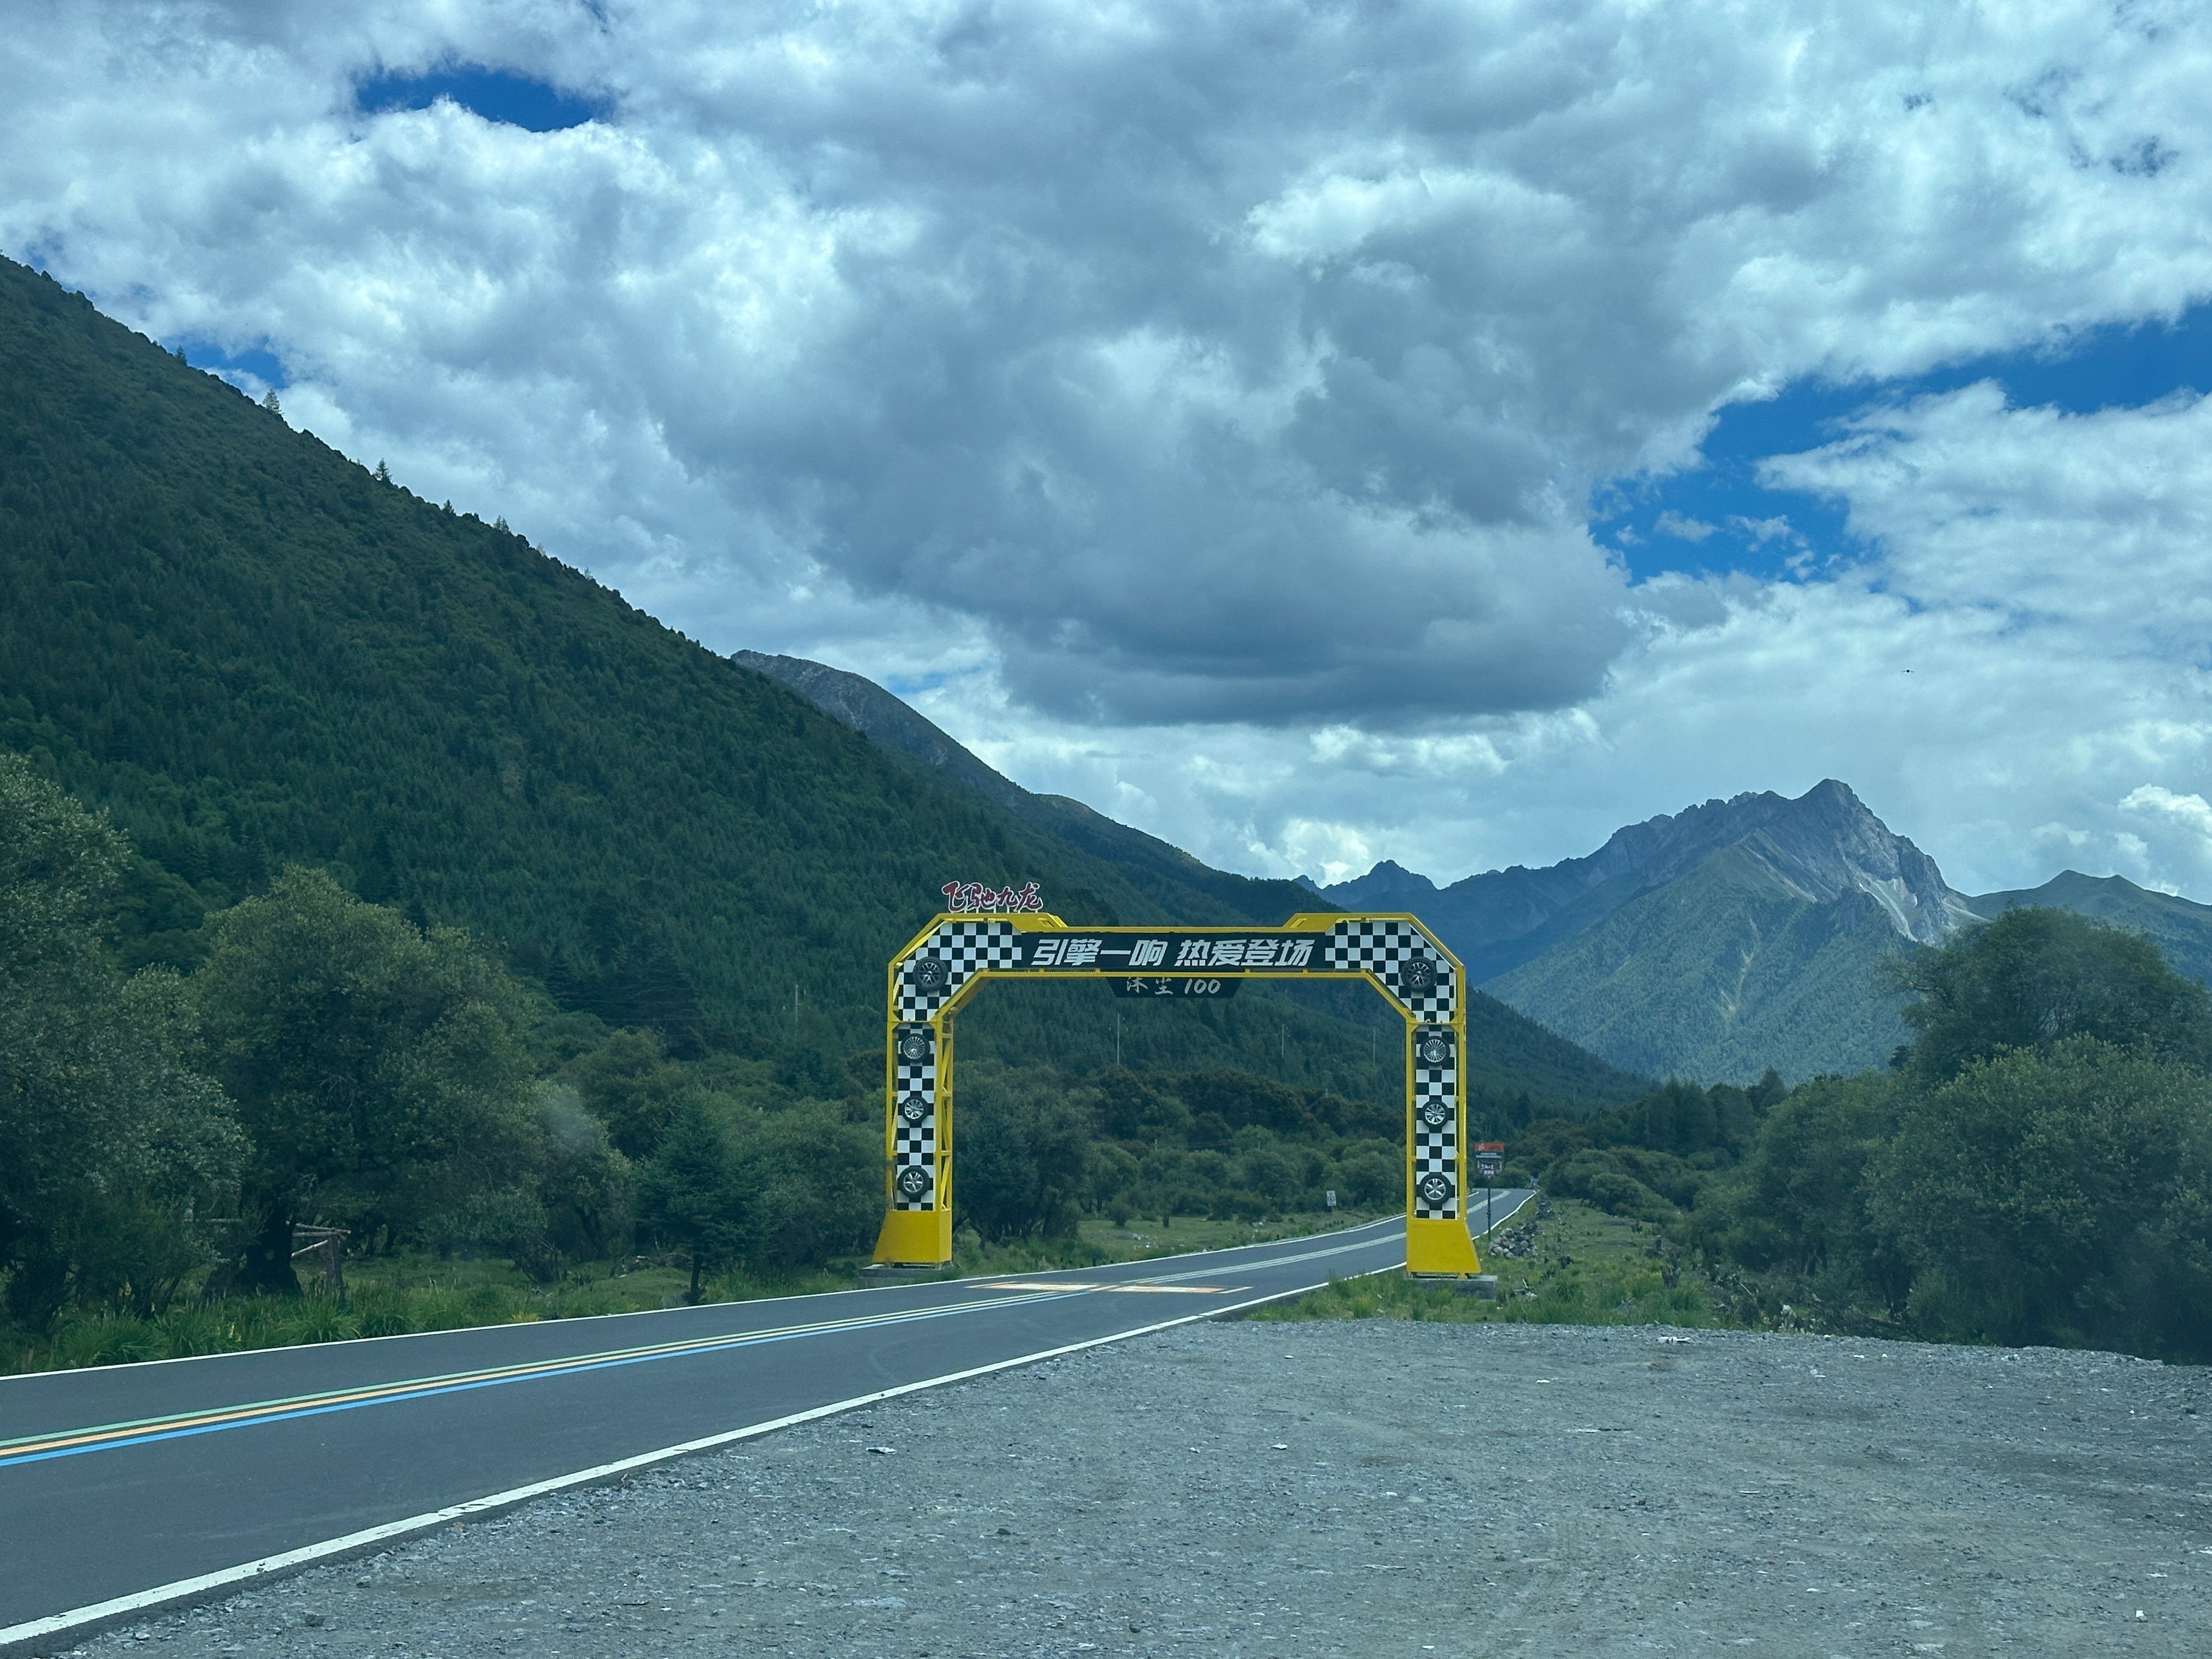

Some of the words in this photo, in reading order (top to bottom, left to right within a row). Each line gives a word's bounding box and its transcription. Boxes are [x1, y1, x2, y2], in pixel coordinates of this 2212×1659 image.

[941, 881, 1043, 912] 飞驰九龙
[1031, 939, 1167, 966] 引擎一响
[1173, 939, 1315, 966] 热爱登场
